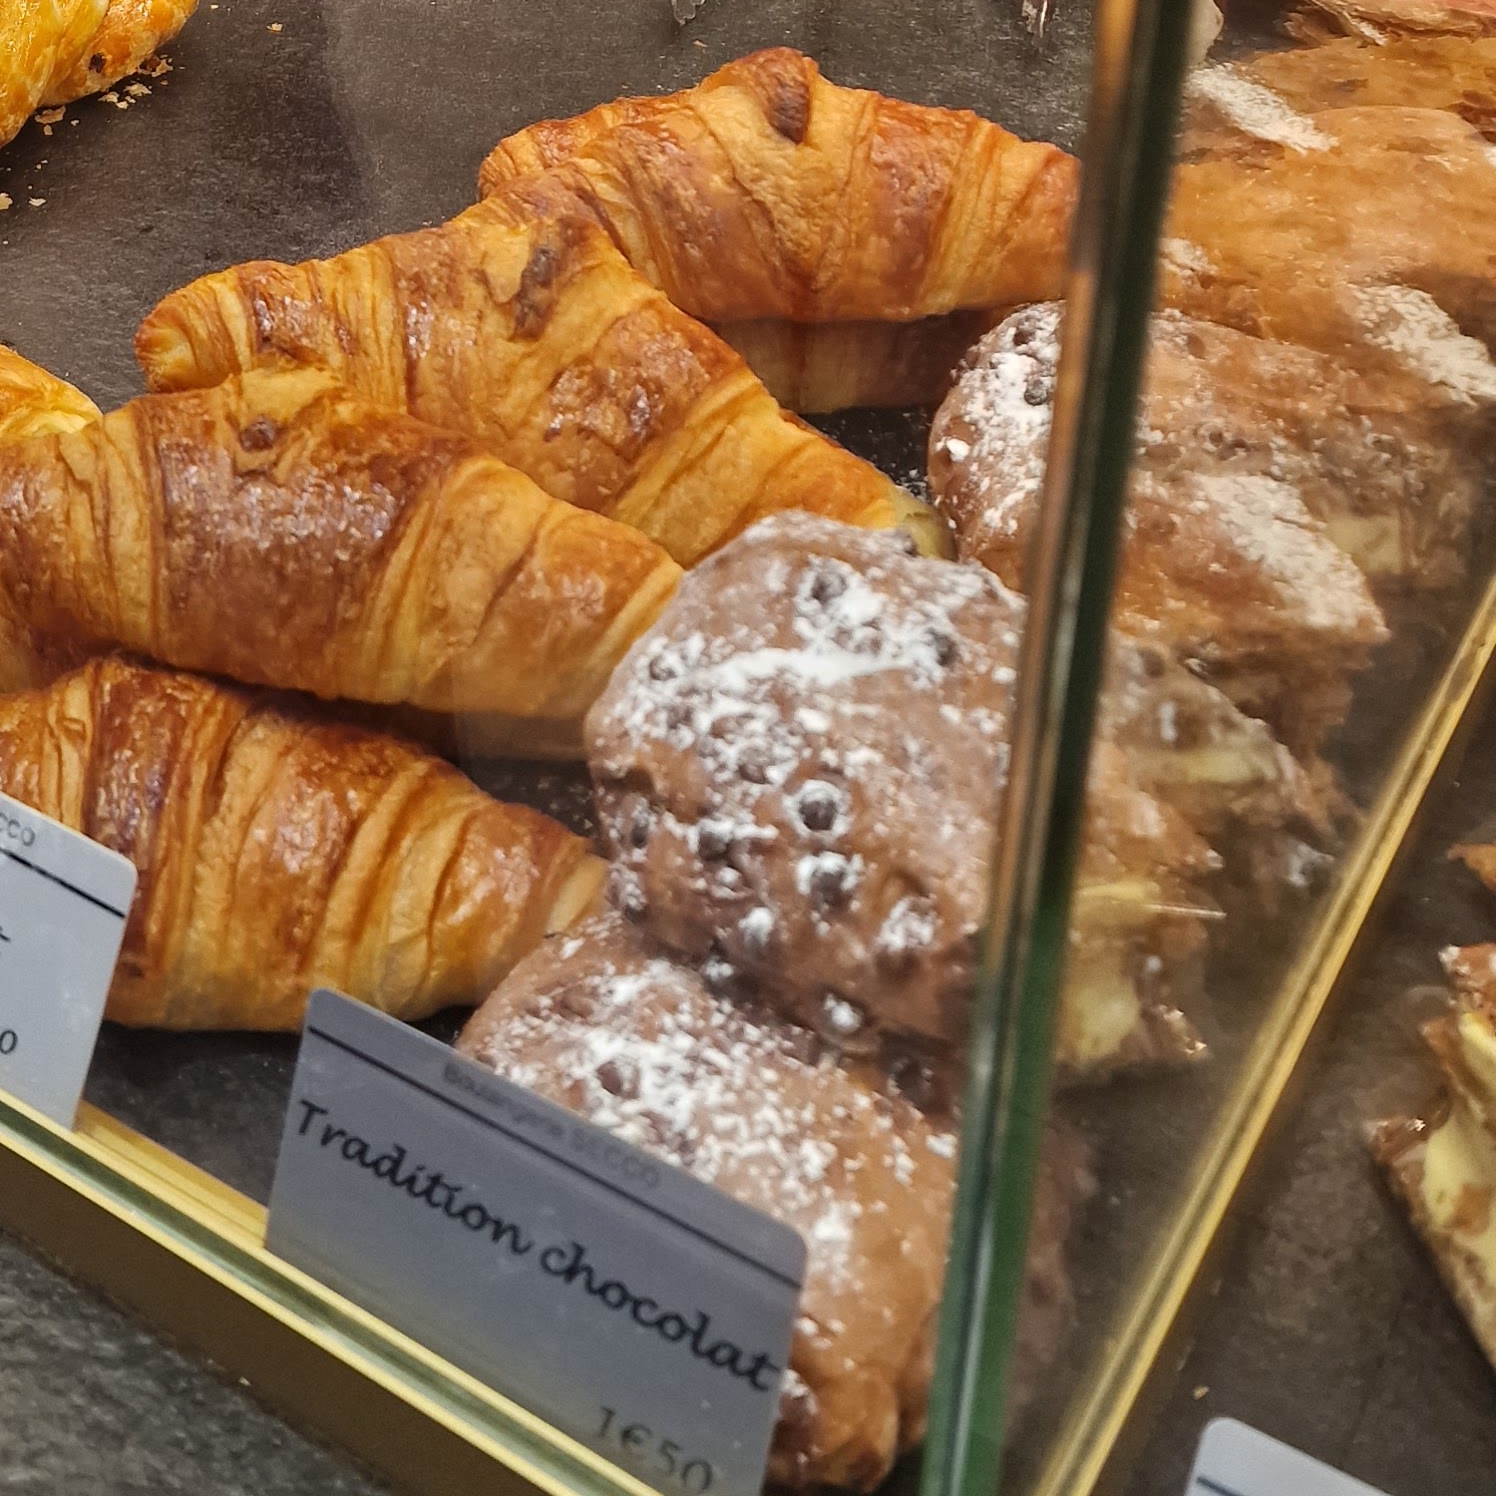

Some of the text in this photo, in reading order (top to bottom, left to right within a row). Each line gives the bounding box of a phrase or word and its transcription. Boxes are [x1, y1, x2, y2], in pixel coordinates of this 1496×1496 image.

[298, 1099, 783, 1393] Tradition chocolat
[592, 1404, 717, 1496] 1€50
